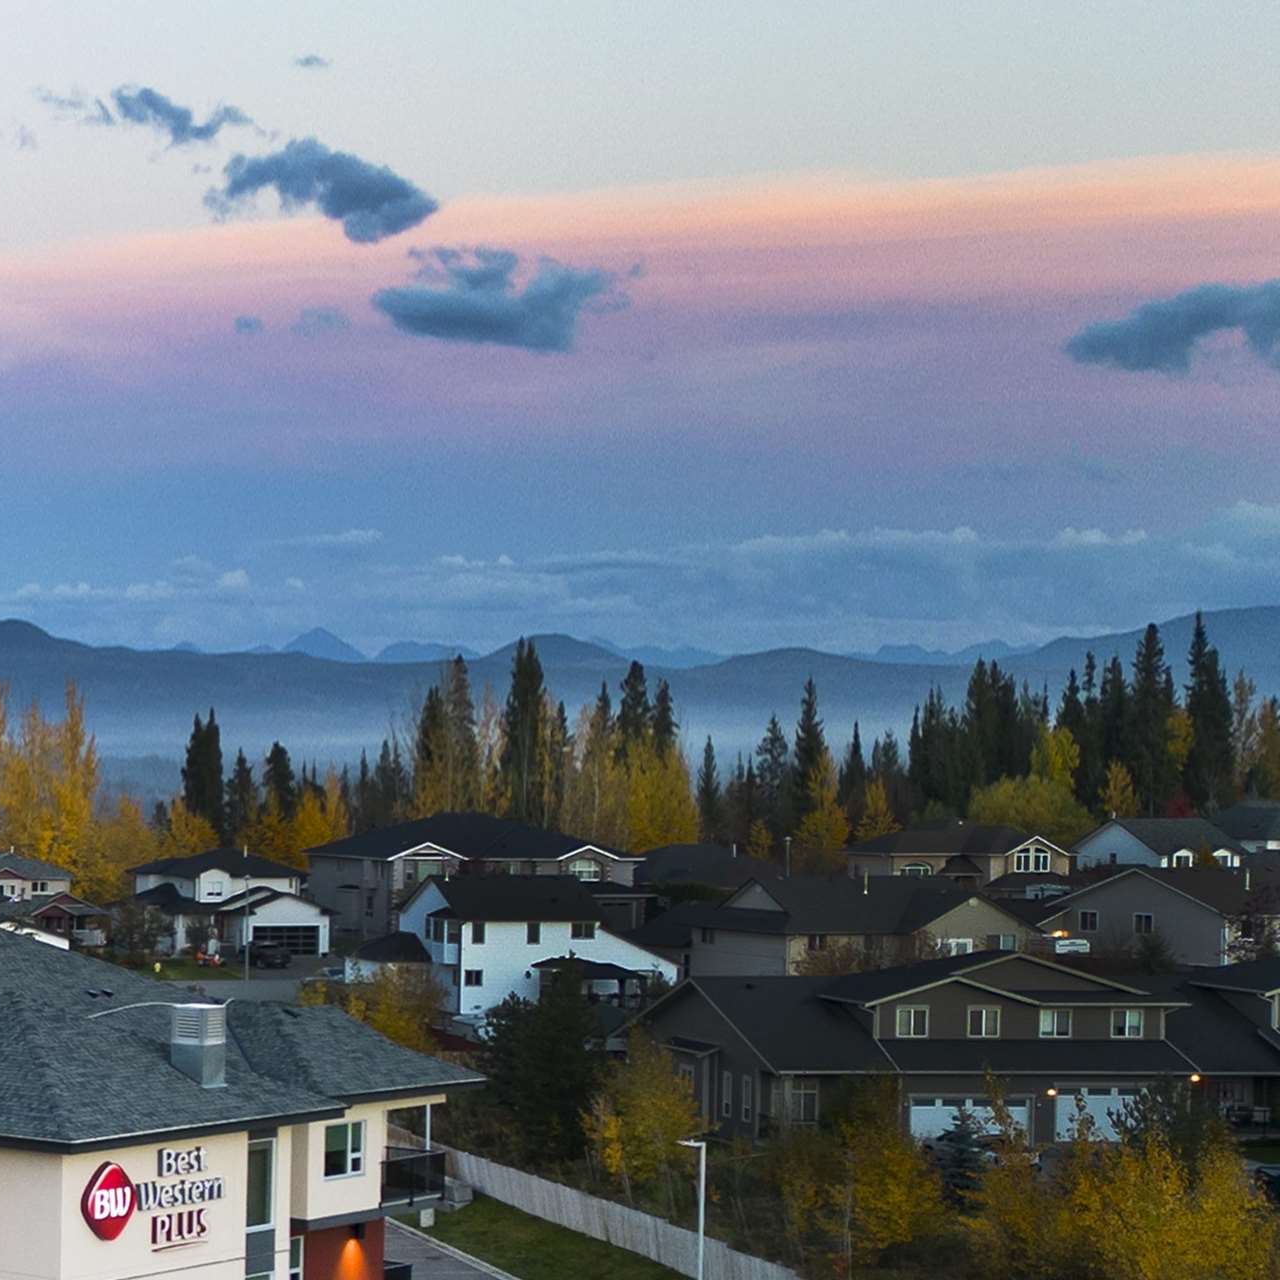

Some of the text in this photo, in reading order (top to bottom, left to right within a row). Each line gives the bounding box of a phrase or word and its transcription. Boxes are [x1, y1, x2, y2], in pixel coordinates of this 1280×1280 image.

[158, 1147, 207, 1177] Best
[94, 1186, 131, 1220] BW
[137, 1177, 225, 1211] Western
[151, 1208, 208, 1244] PLUS
